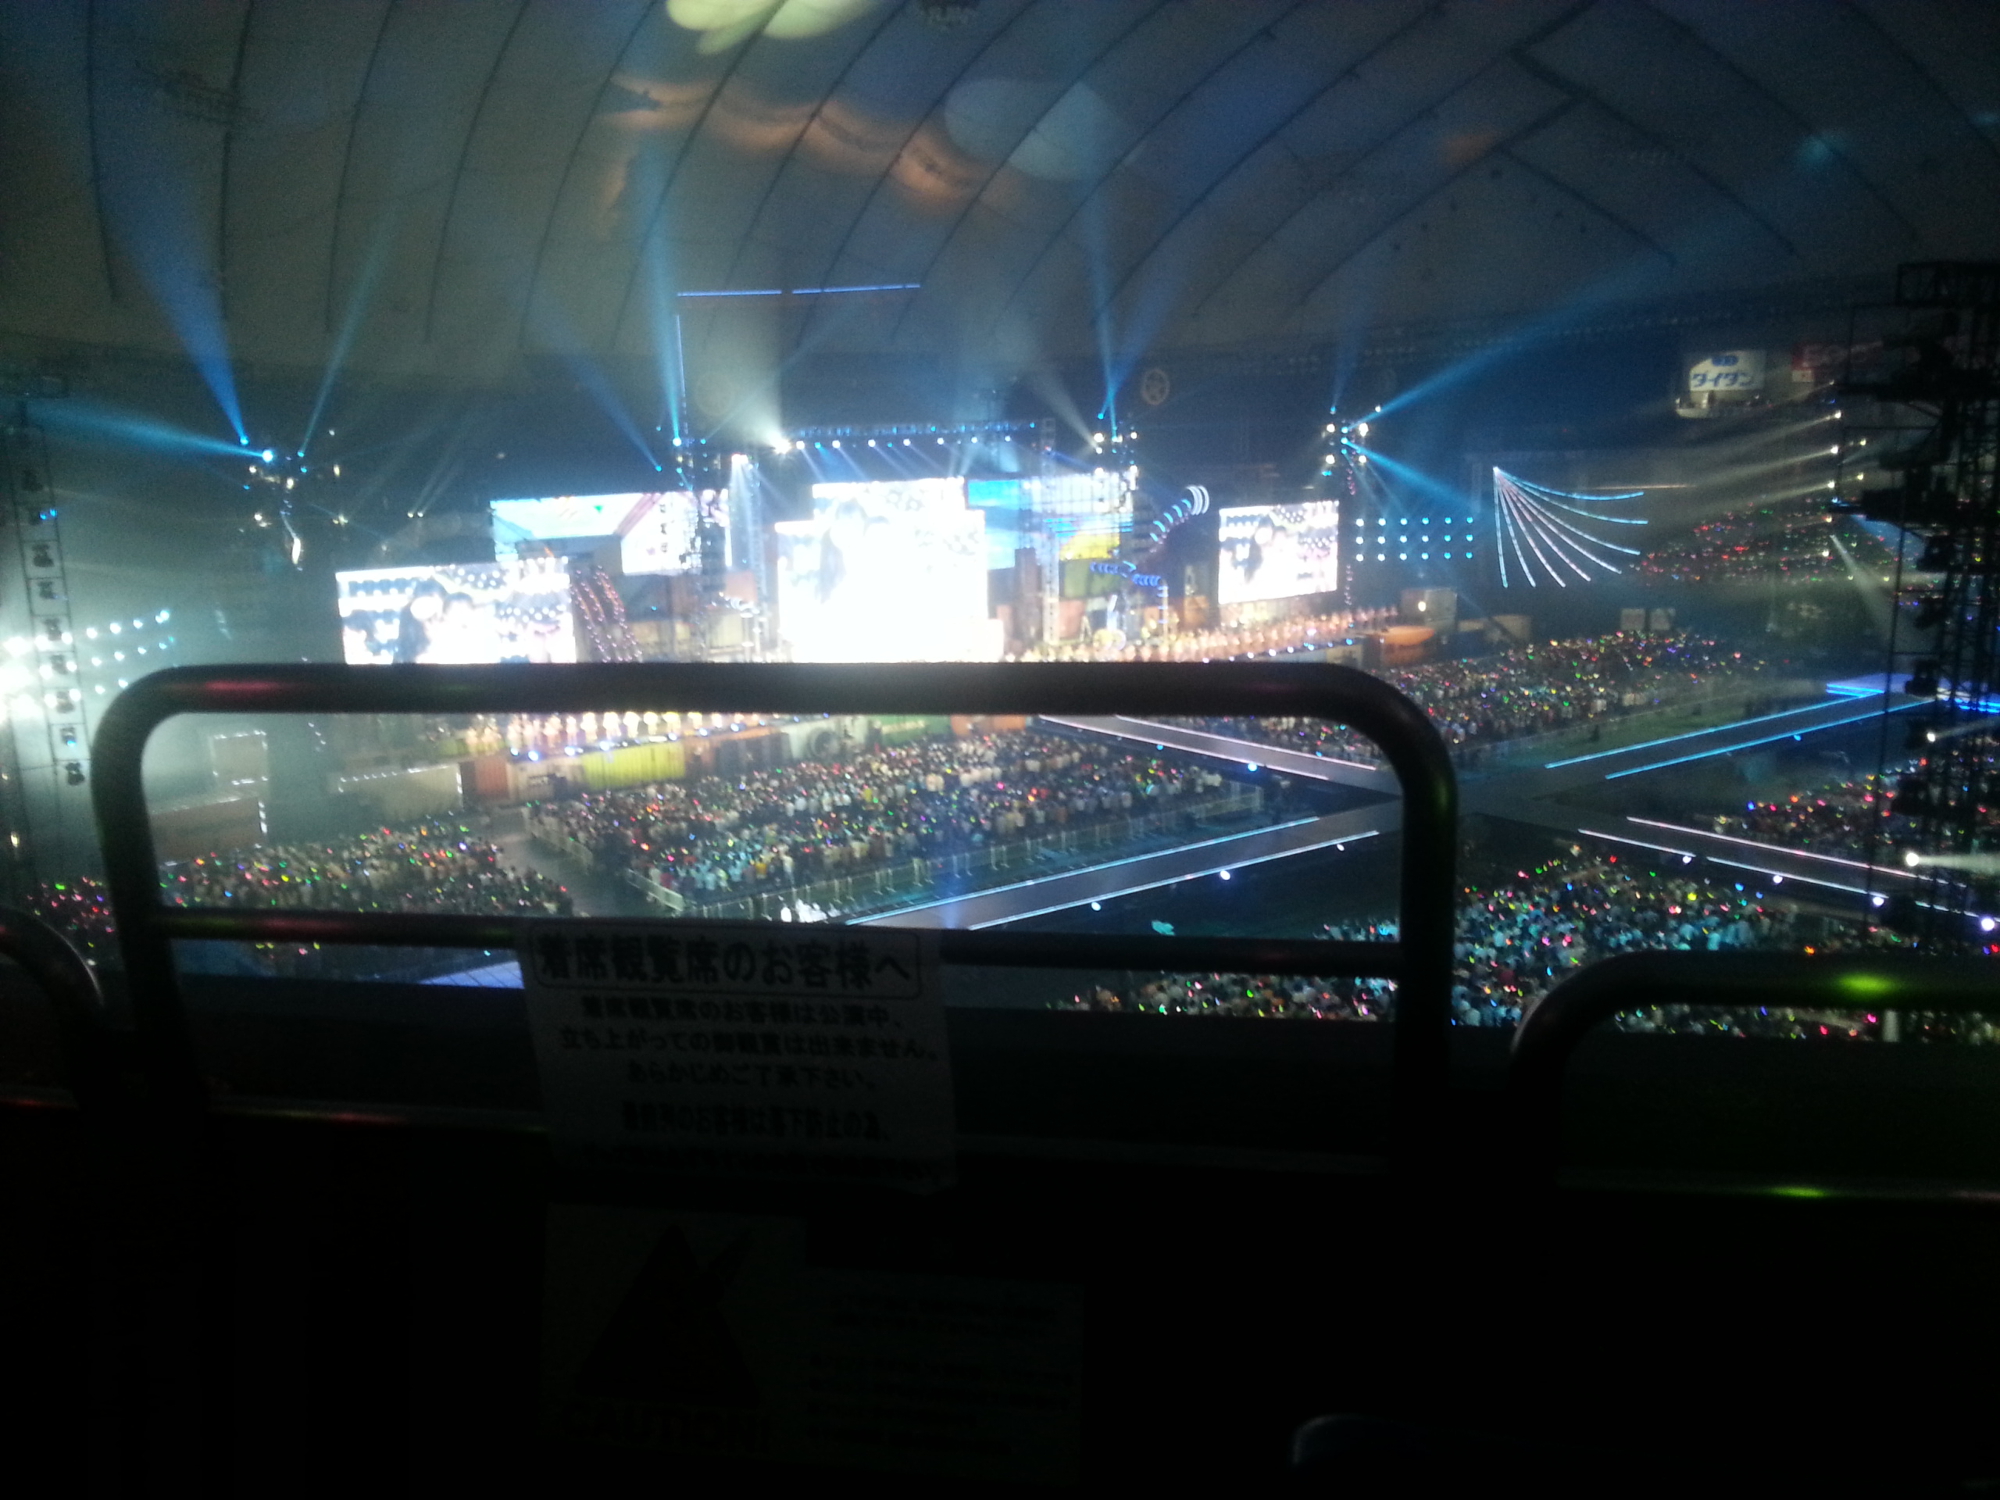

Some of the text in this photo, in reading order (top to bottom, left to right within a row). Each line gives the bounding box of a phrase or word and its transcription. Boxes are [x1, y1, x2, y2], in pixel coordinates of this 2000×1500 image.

[537, 933, 911, 989] 着席観覧席のお客様へ
